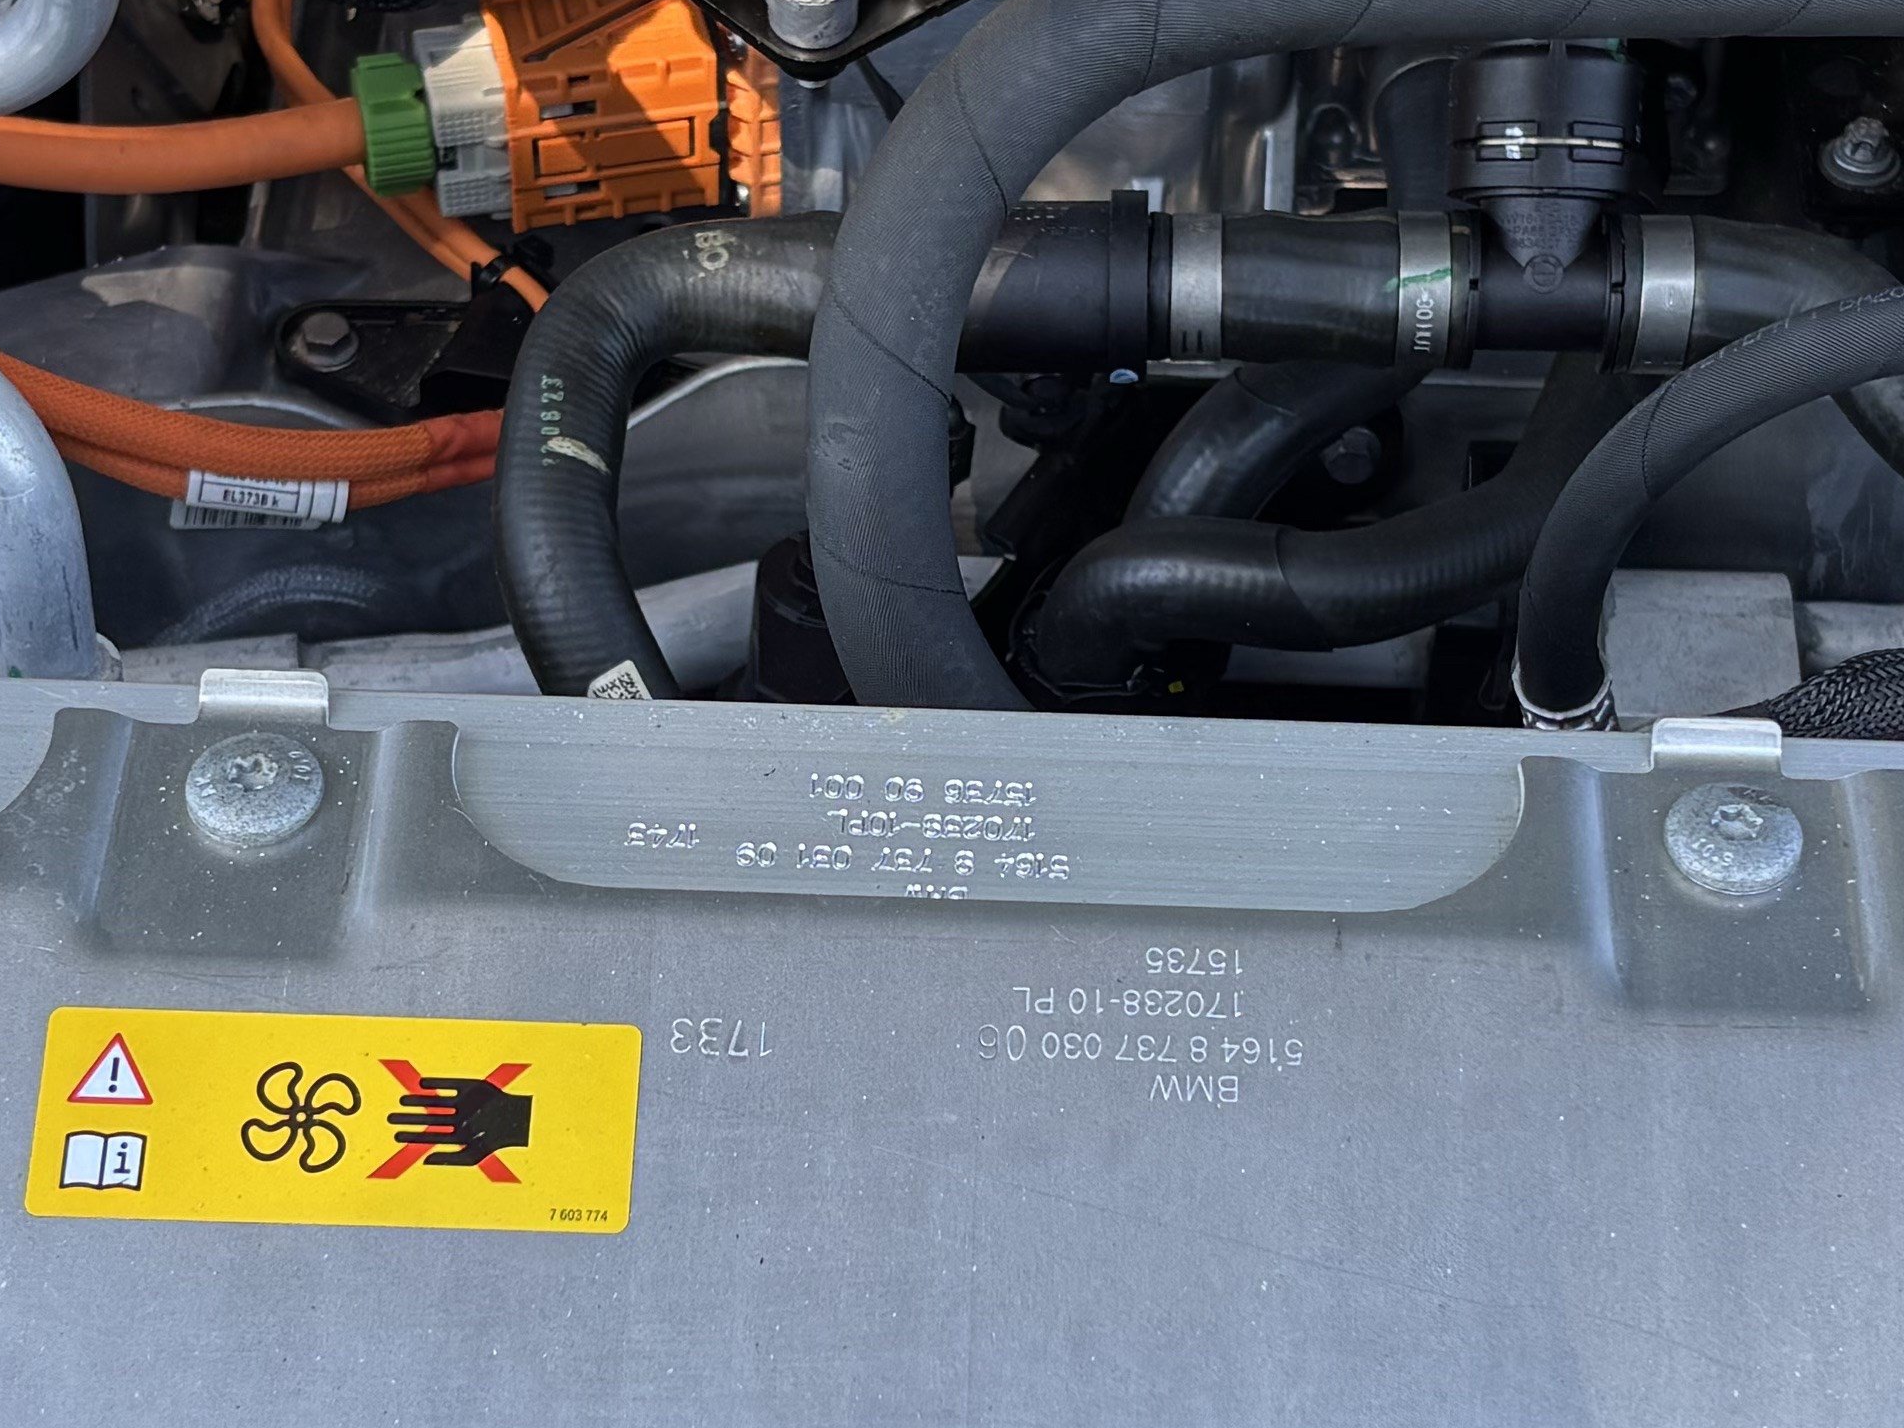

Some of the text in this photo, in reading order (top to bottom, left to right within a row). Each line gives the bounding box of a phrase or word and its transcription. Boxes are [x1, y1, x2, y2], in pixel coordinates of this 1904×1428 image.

[1145, 946, 1245, 976] 15735
[1011, 985, 1244, 1019] 170238-10 PL
[669, 1017, 774, 1060] 1733
[1040, 1030, 1103, 1061] 030
[1114, 1033, 1179, 1064] 737
[1189, 1034, 1209, 1064] 8
[1219, 1036, 1304, 1066] 5164
[1148, 1073, 1240, 1104] BMW
[587, 1208, 609, 1223] 774
